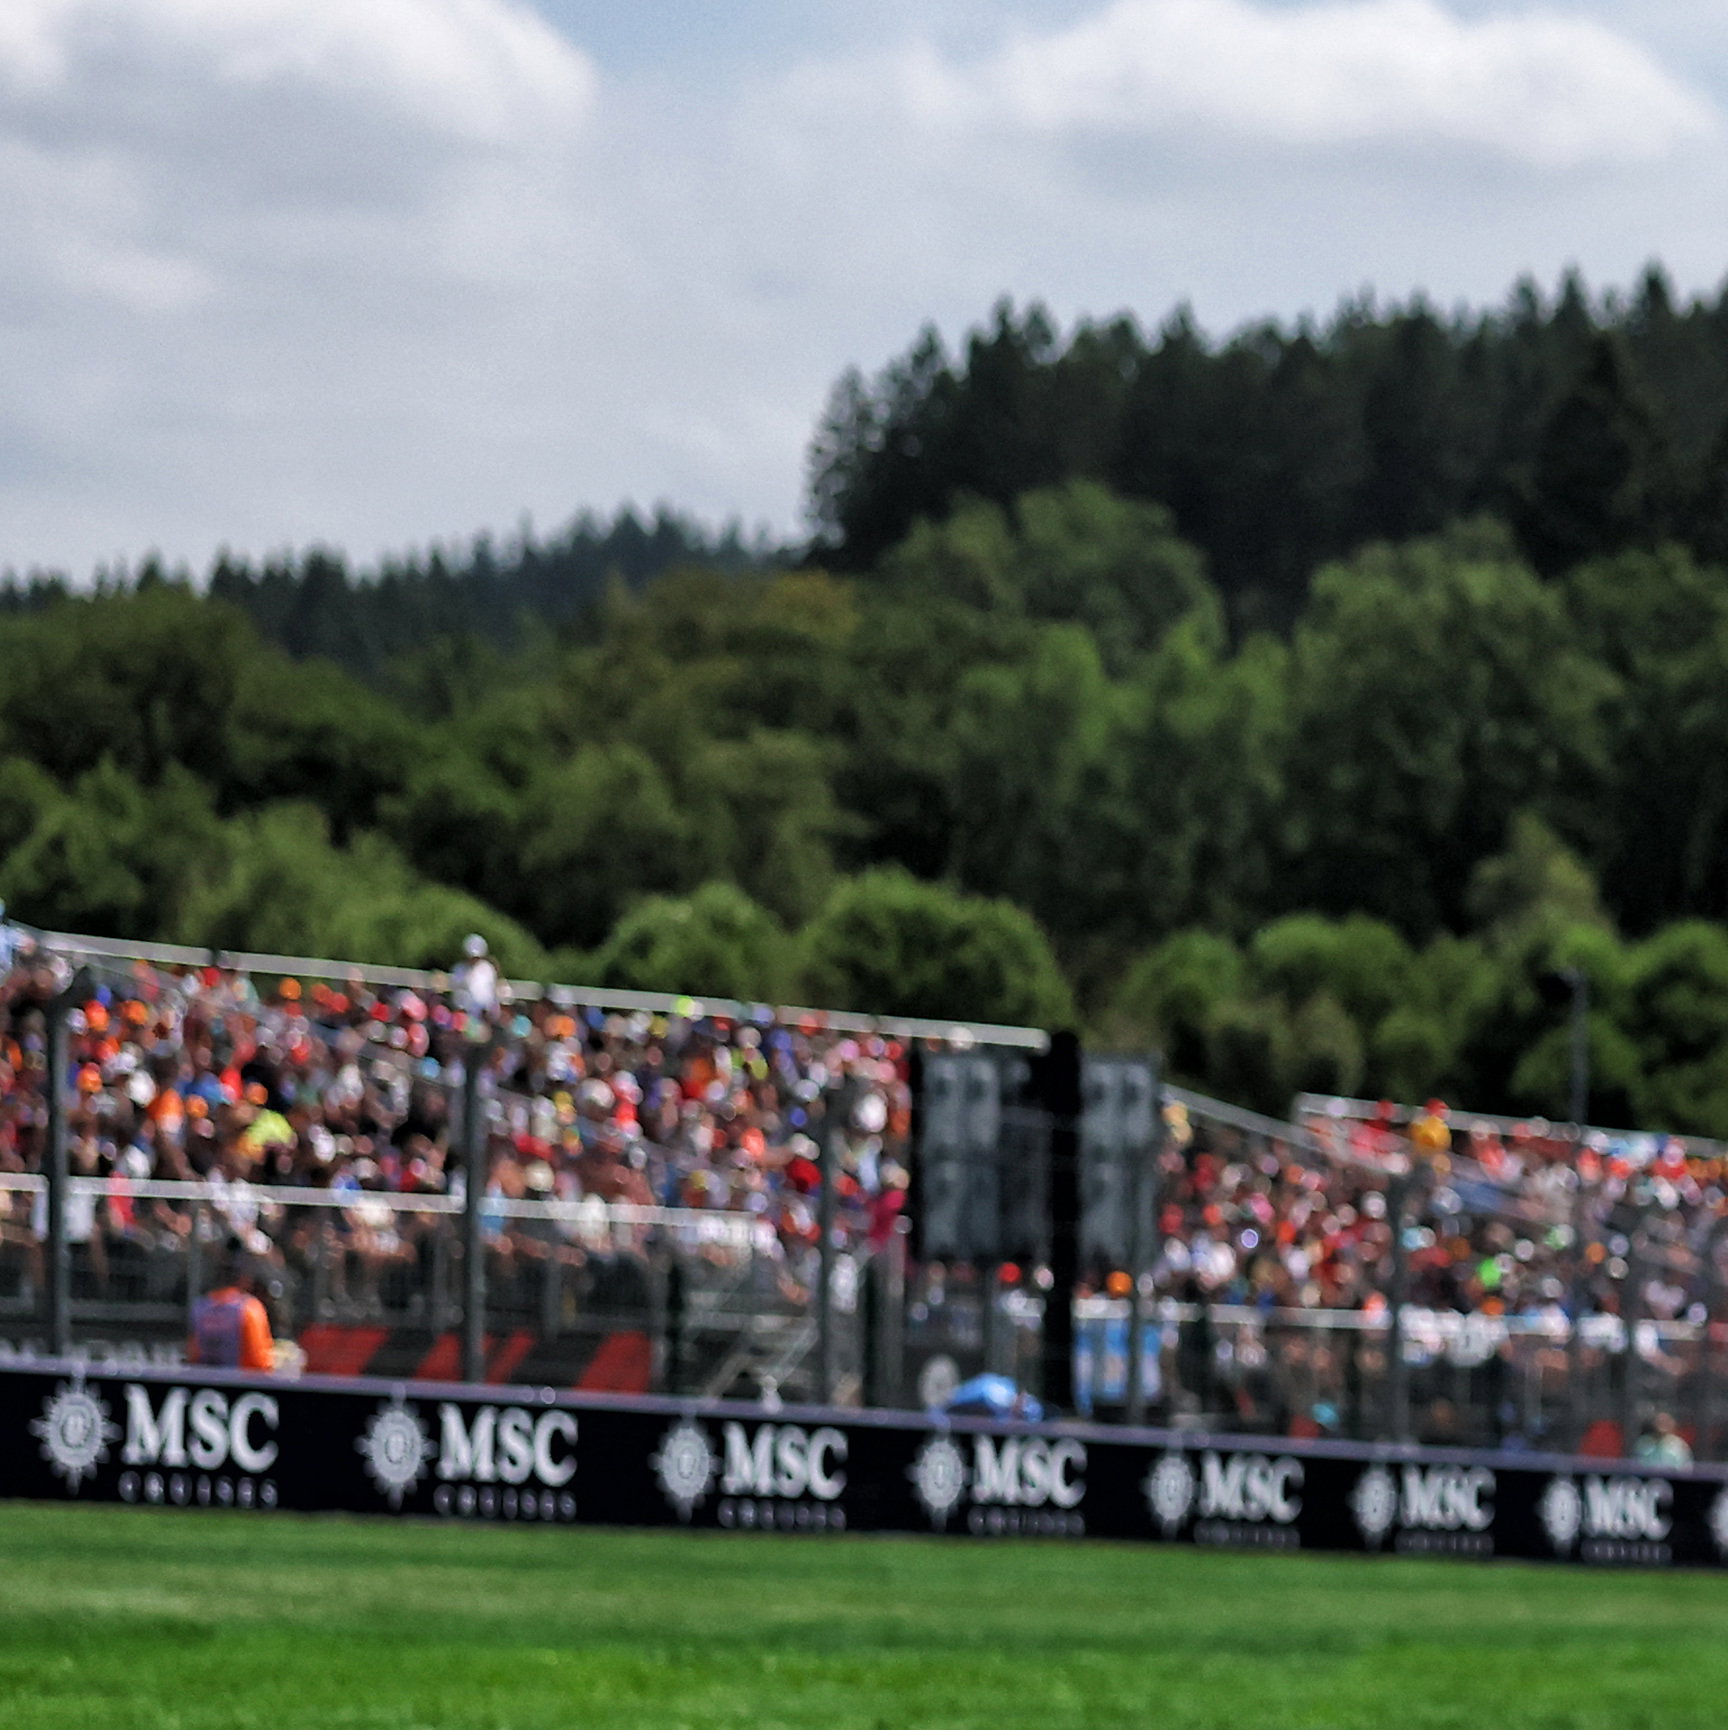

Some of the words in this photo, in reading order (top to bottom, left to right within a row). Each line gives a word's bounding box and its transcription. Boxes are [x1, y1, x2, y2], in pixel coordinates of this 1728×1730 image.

[123, 1384, 279, 1472] MSC
[437, 1402, 578, 1486] MSC
[722, 1421, 848, 1499] MSC
[971, 1435, 1087, 1507] MSC
[1200, 1449, 1304, 1523] MSC
[1399, 1463, 1496, 1531] MSC
[1583, 1473, 1673, 1541] MSC
